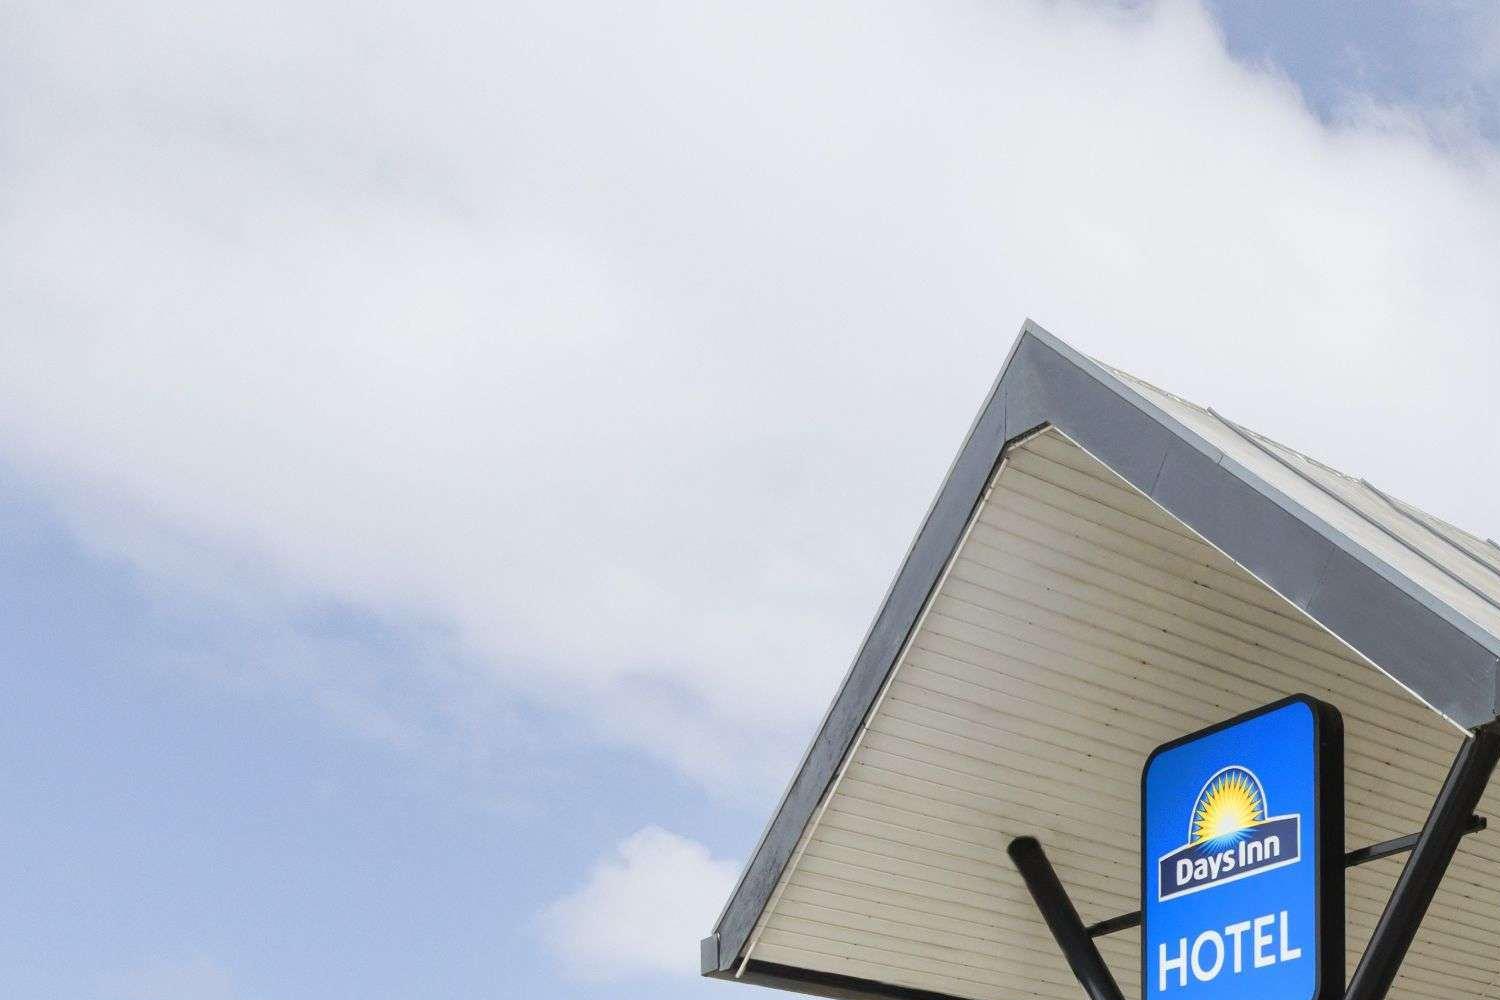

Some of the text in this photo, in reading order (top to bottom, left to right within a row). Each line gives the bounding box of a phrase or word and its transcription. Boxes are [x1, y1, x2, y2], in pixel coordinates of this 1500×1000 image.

[1176, 835, 1280, 886] Days Inn
[1158, 910, 1302, 992] HOTEL
